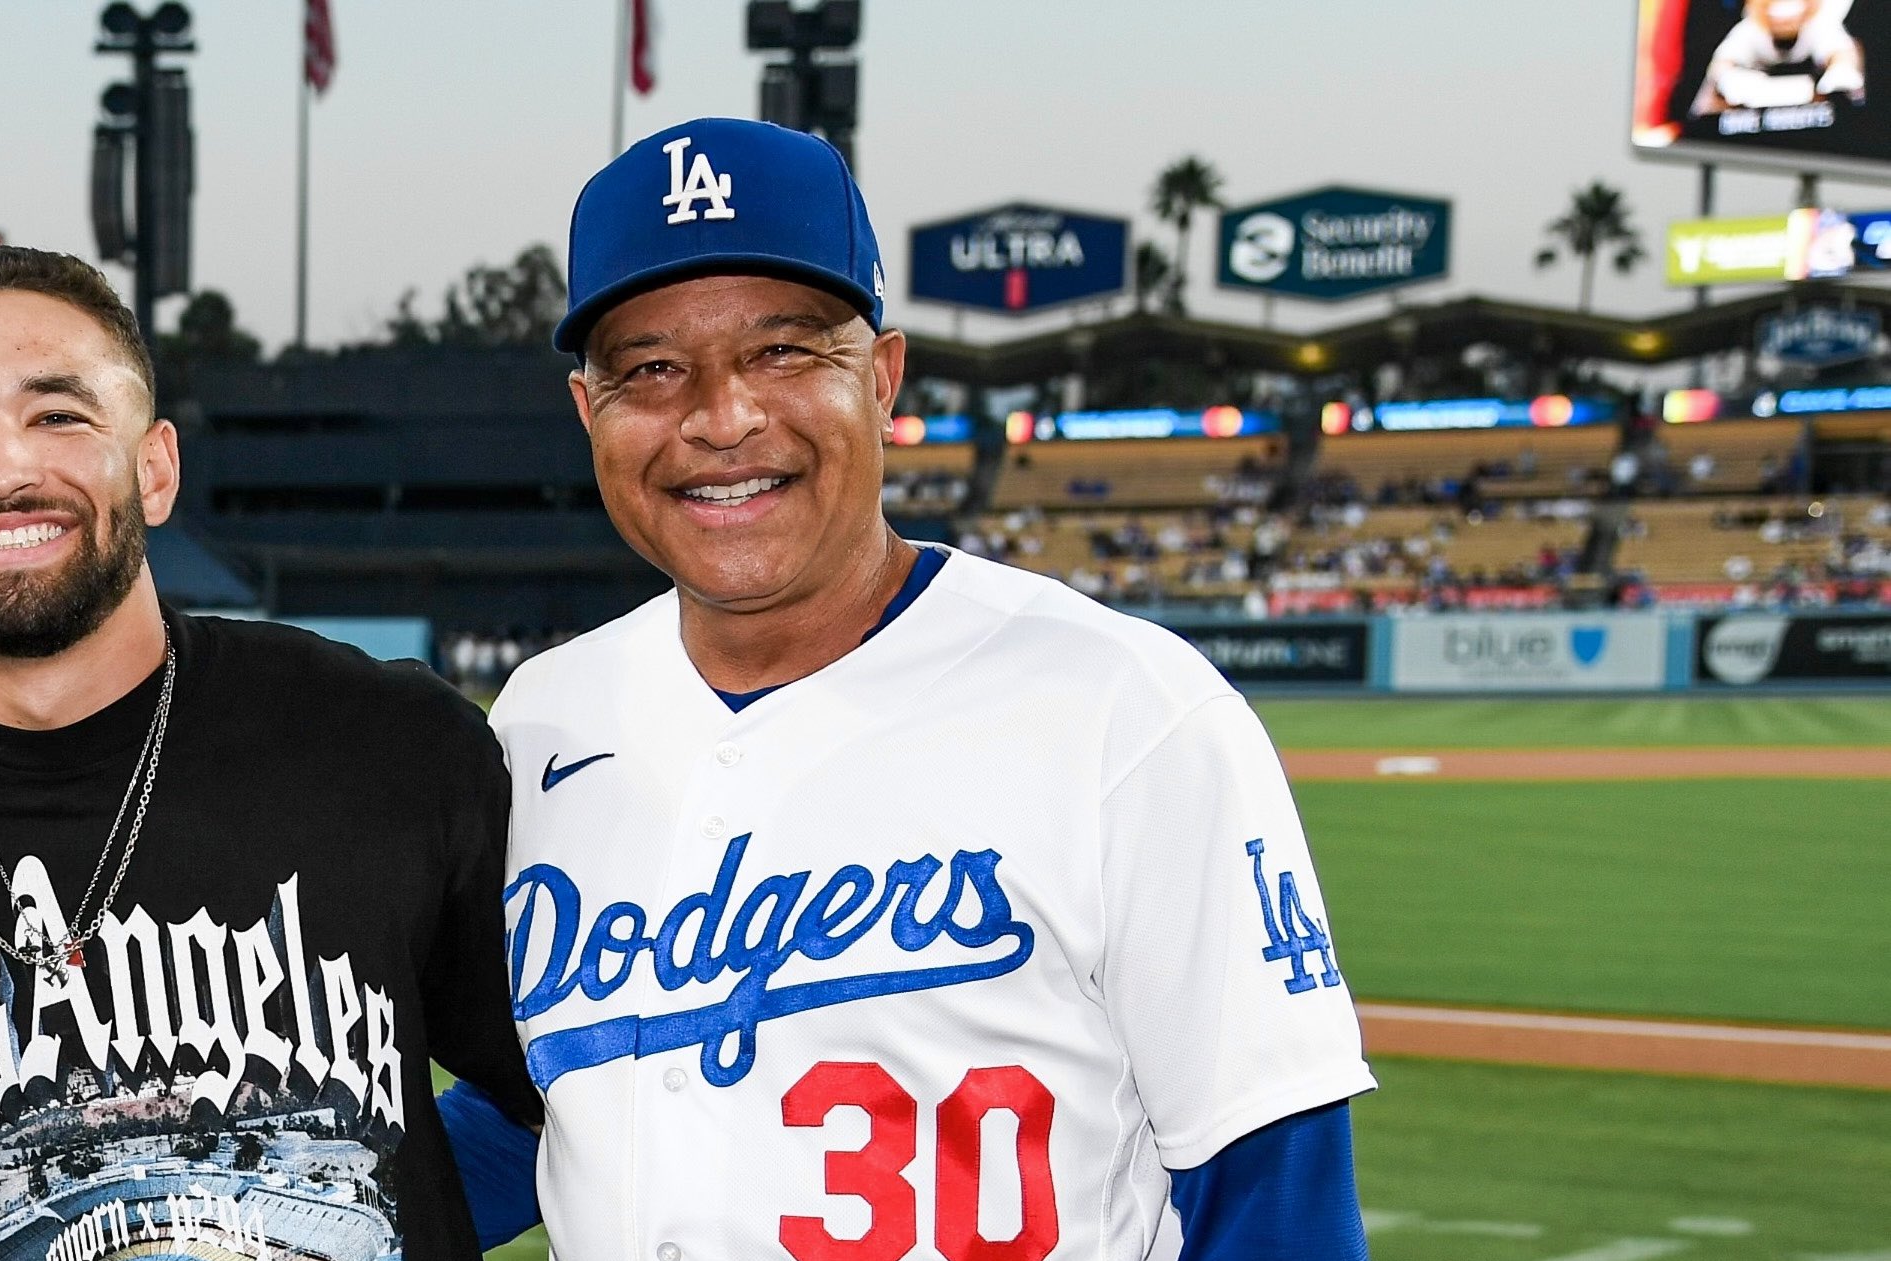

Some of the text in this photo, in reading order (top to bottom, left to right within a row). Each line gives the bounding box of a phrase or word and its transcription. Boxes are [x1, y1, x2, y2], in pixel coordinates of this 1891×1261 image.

[663, 137, 735, 225] LA
[950, 230, 1086, 271] ULTRA
[1300, 206, 1436, 248] Security
[1301, 243, 1414, 279] Benefit
[1442, 624, 1556, 667] blue
[1245, 838, 1340, 994] LA
[12, 855, 404, 1132] Angeles
[502, 832, 1034, 1092] Dodgers
